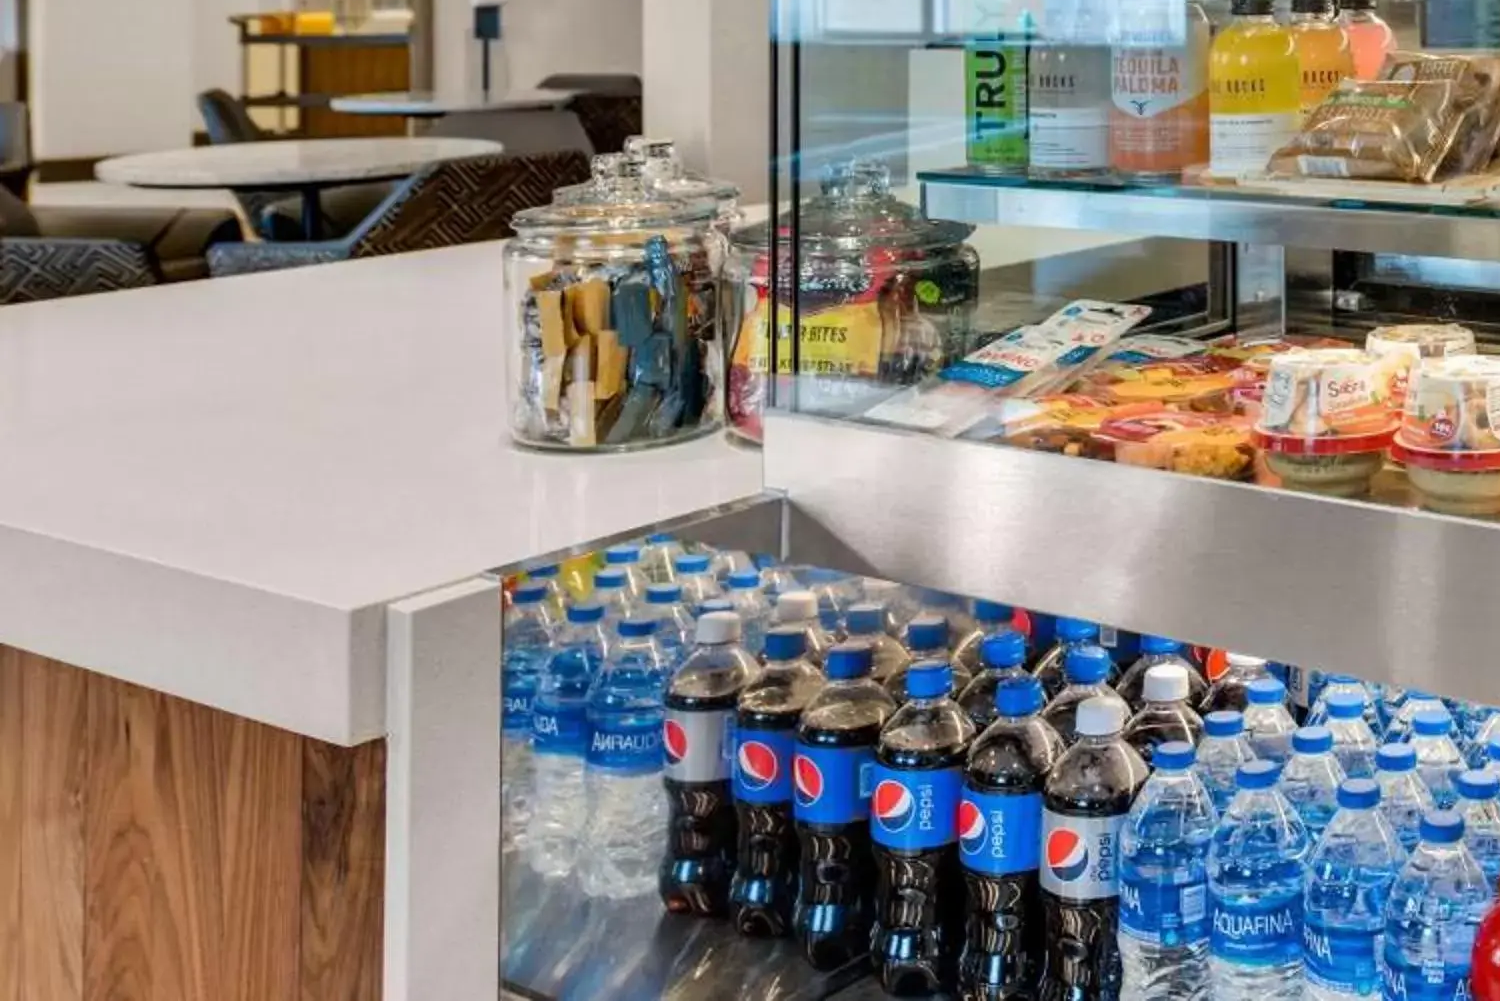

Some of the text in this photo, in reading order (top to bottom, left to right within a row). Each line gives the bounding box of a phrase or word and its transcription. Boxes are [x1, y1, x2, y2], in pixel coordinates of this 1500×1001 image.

[1114, 56, 1180, 74] TEQUILA
[1115, 75, 1179, 93] PALOMA
[808, 326, 848, 344] BITES
[919, 784, 934, 831] pepsi
[990, 809, 1006, 859] pepsi
[1097, 832, 1112, 883] pepsi
[1213, 907, 1294, 941] AQUAFINA
